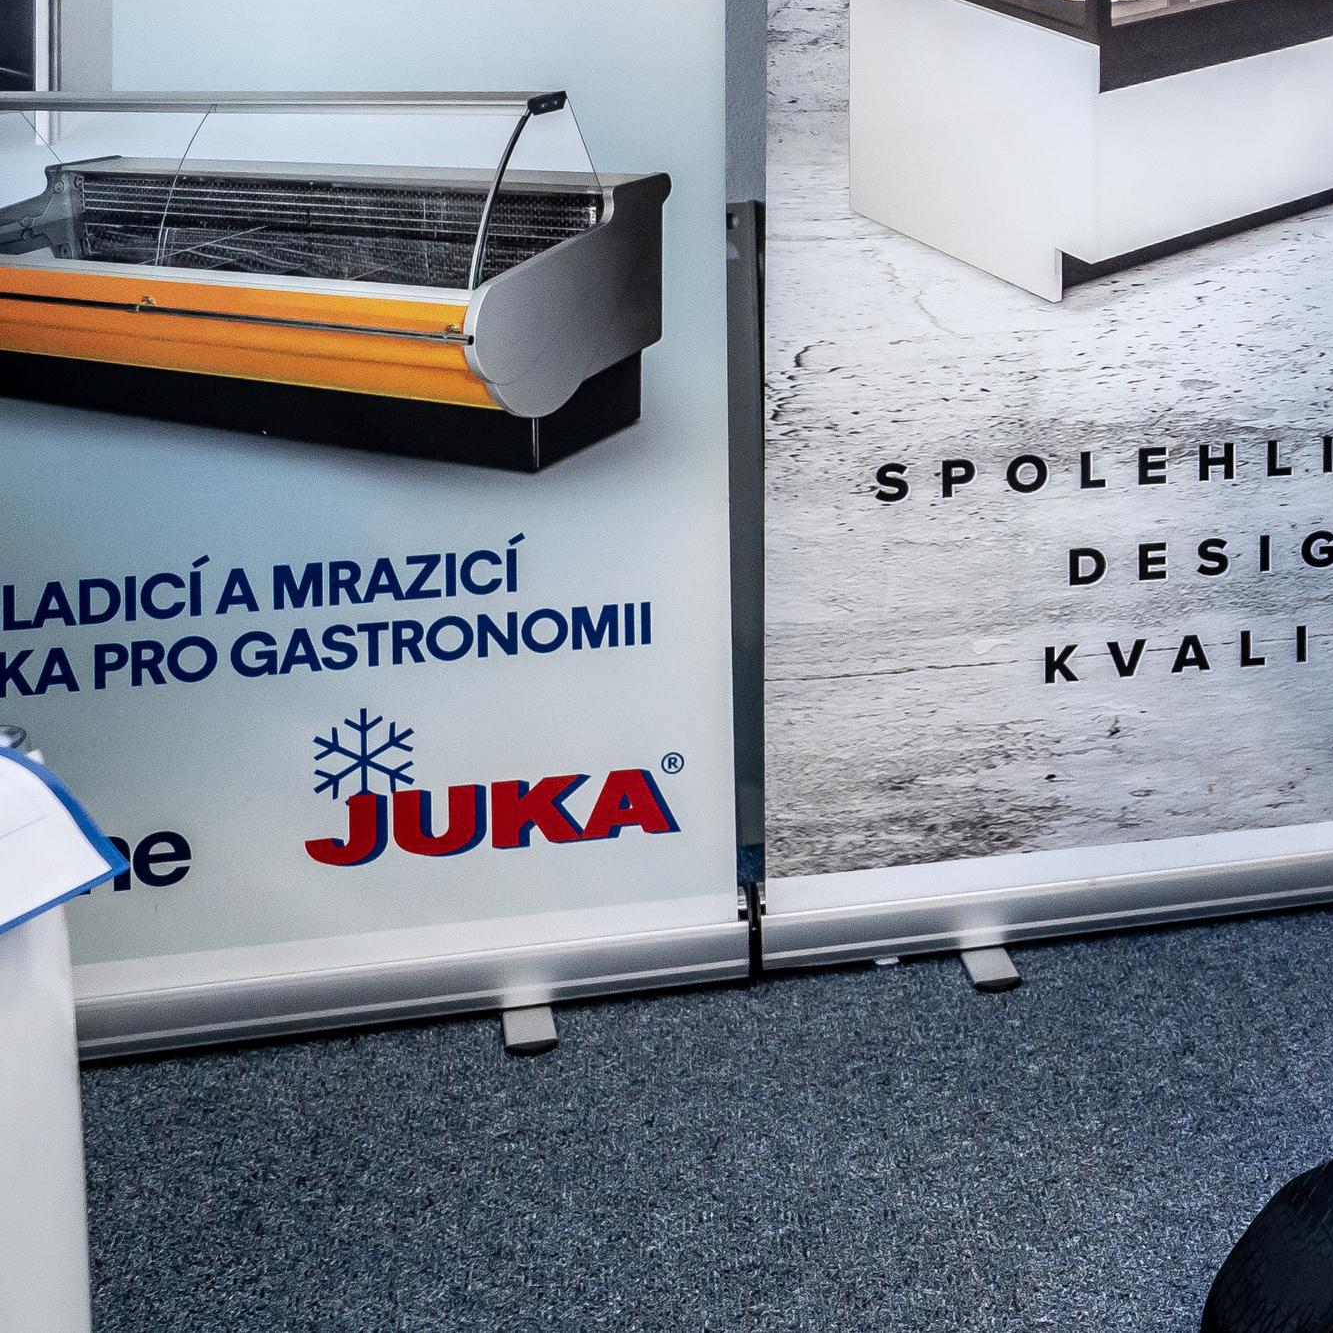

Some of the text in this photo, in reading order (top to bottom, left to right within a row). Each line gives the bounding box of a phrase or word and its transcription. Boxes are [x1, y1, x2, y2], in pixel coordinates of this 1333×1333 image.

[3, 533, 525, 631] LADICÍ A MRAZICÍ
[94, 635, 218, 690] PRO
[230, 601, 652, 677] GASTRONOMII
